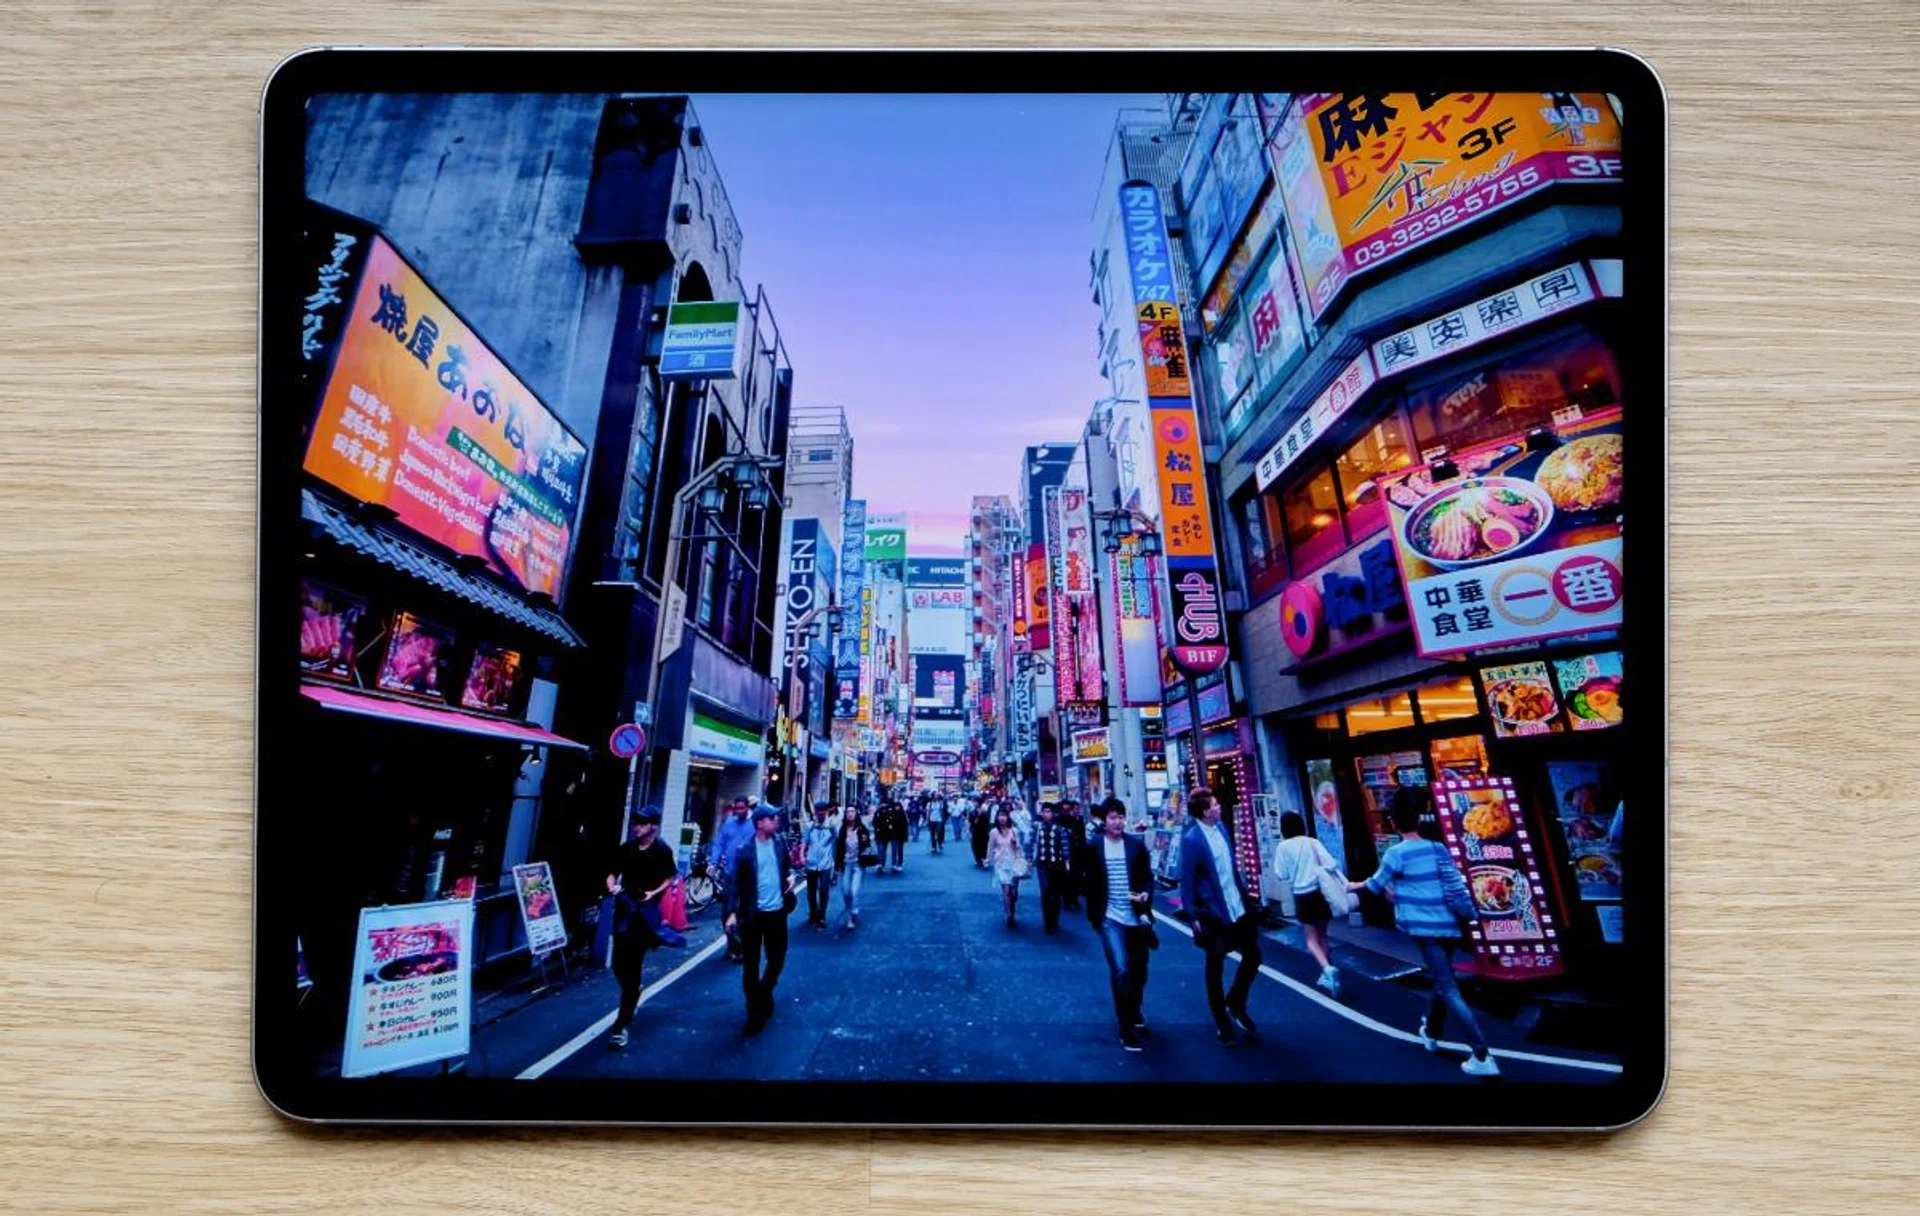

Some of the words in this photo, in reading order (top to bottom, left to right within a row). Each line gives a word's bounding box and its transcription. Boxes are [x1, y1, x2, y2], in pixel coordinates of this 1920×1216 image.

[1458, 117, 1516, 160] 3F
[1567, 155, 1622, 175] 3F
[1125, 187, 1166, 281] カラオケ
[1355, 166, 1539, 266] 03-3232-5755
[1317, 266, 1341, 303] 3F
[1141, 303, 1173, 319] 4F
[668, 328, 734, 340] FamilyMart
[1160, 325, 1187, 378] 麻雀
[1165, 450, 1195, 506] 松屋
[784, 538, 817, 669] SEIKO-EN
[1176, 572, 1220, 642] HUB
[1425, 579, 1486, 610] 中華
[1432, 606, 1494, 637] 食堂
